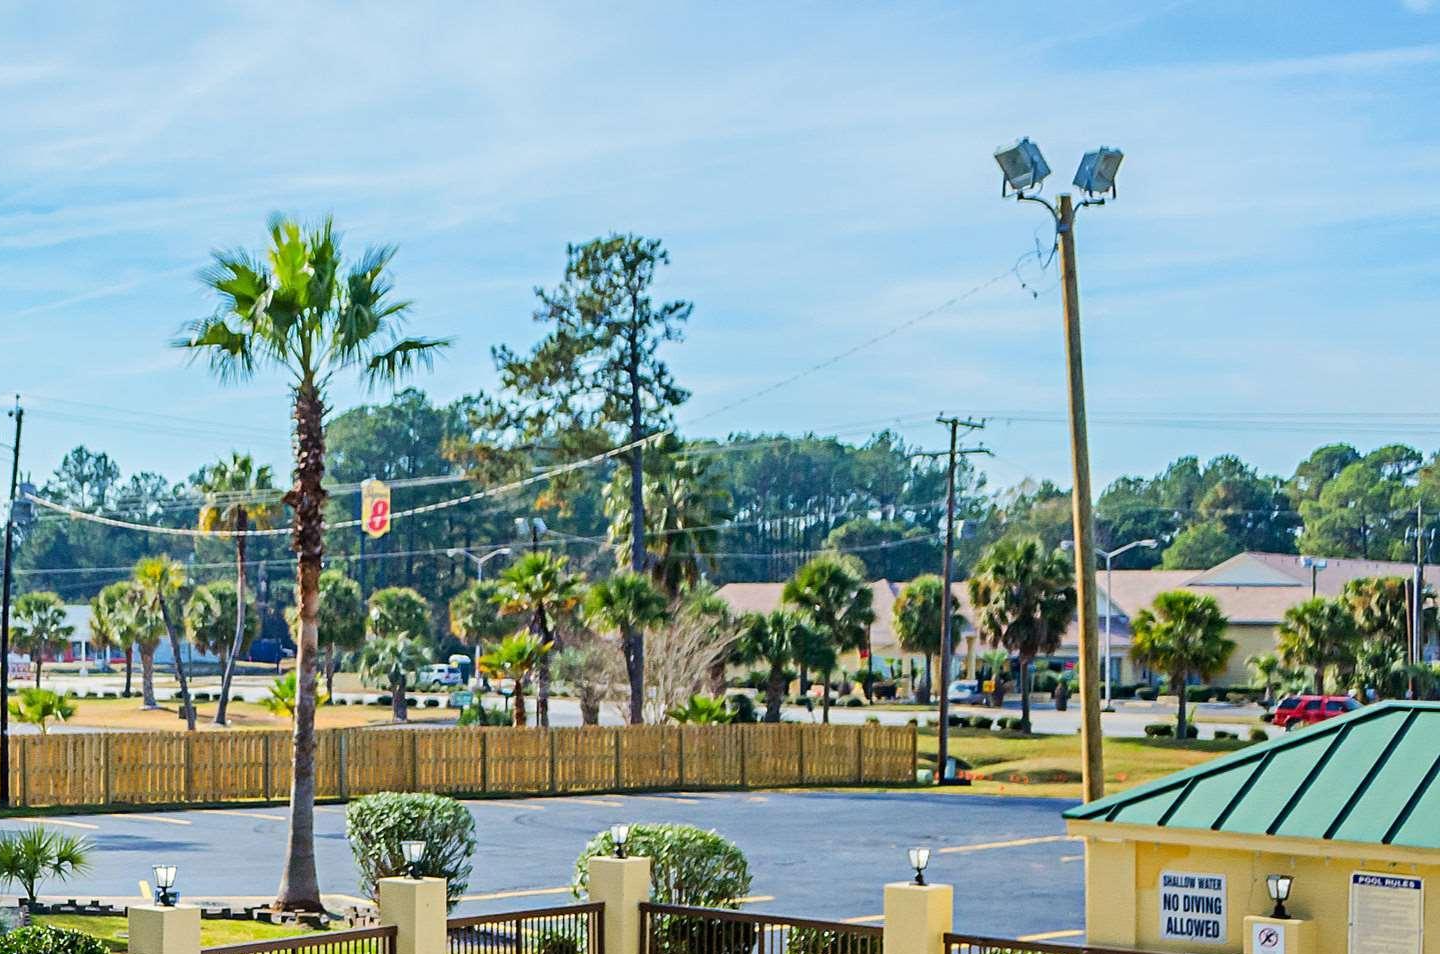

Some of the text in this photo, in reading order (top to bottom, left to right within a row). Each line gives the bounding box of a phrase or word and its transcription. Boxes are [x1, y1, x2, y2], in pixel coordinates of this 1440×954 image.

[369, 500, 388, 530] 8
[1163, 875, 1222, 890] SHALLOW WATER
[1358, 876, 1415, 888] POOL RULES
[1163, 893, 1222, 915] NO DIVING
[1166, 916, 1220, 938] ALLOWED
